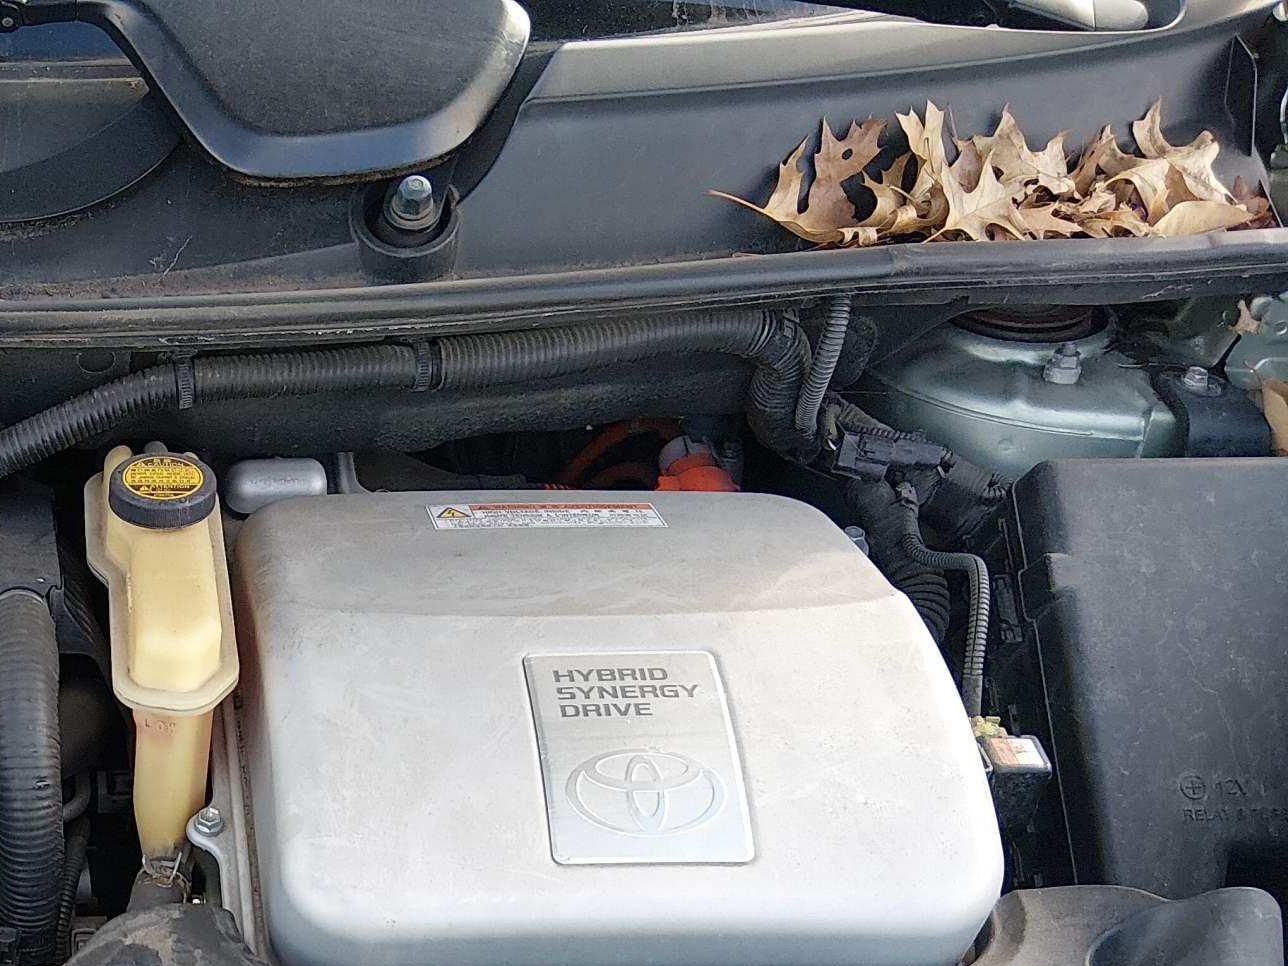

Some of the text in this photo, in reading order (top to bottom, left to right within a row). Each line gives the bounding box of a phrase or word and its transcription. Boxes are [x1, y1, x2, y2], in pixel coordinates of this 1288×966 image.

[553, 667, 668, 683] HYBRID
[555, 684, 698, 700] SYNERGY
[559, 703, 654, 718] DRIVE
